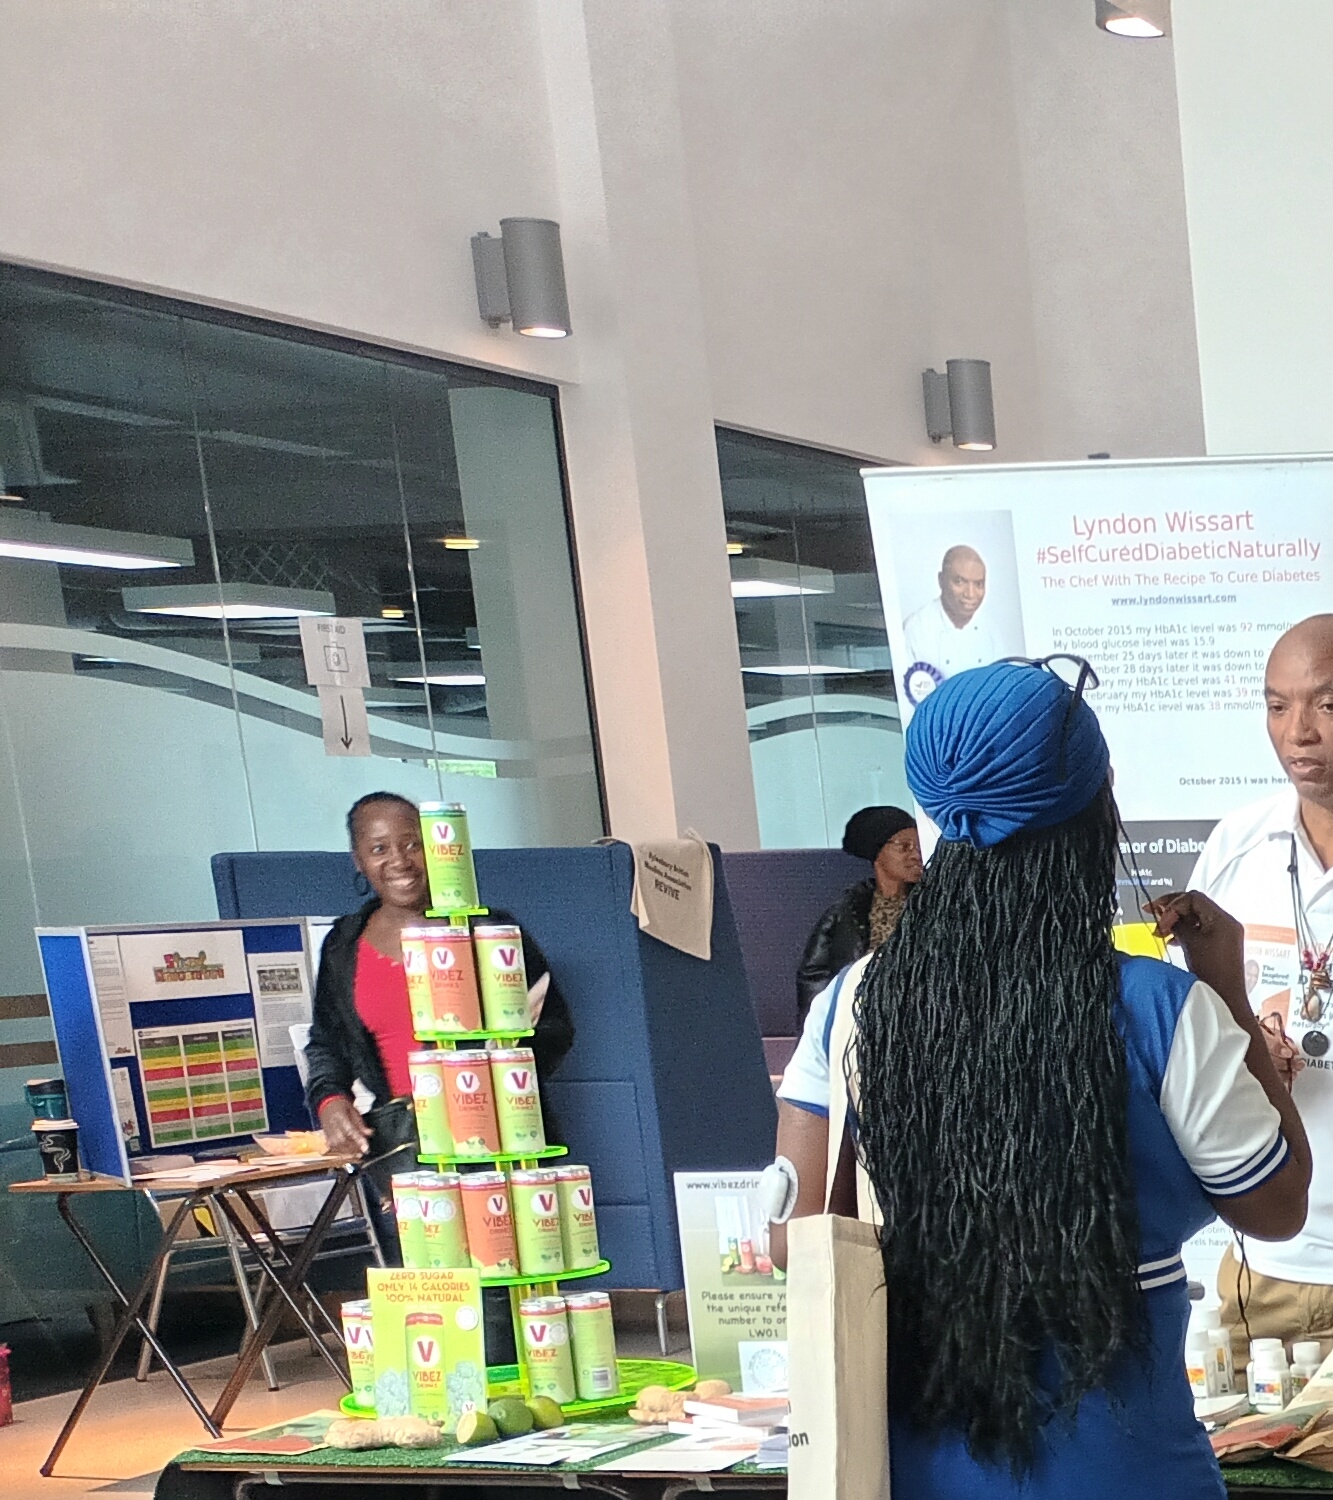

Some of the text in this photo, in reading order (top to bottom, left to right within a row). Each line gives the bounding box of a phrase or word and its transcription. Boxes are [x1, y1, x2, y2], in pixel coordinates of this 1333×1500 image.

[1072, 510, 1255, 541] Lyndon Wissart
[1036, 538, 1321, 564] #SelfCuredDiabeticNaturally
[1041, 568, 1321, 588] The Chef With The Recipe To Cure Diabetes
[1111, 593, 1237, 607] www.lyndonwissart.com
[1052, 627, 1062, 637] In
[1064, 626, 1104, 637] October
[1107, 625, 1133, 636] 2015
[1136, 627, 1152, 637] my
[1154, 624, 1188, 635] HbA1c
[1190, 623, 1215, 634] level
[1217, 624, 1237, 633] was
[1053, 640, 1069, 651] My
[1071, 639, 1099, 650] blood
[1101, 638, 1140, 650] glucose
[1142, 637, 1167, 649] level
[1170, 638, 1190, 647] was
[1121, 648, 1264, 663] 25 days later it was down to
[1139, 663, 1164, 676] days
[1165, 662, 1190, 673] later
[1192, 662, 1199, 673] it
[1202, 663, 1222, 672] was
[1224, 661, 1252, 672] down
[1254, 661, 1265, 671] to
[1117, 677, 1133, 688] my
[1201, 676, 1221, 685] was
[1131, 691, 1147, 701] my
[1186, 688, 1210, 698] level
[1212, 688, 1232, 697] was
[1104, 703, 1120, 714] my
[1158, 700, 1183, 711] level
[1185, 701, 1206, 710] was
[1179, 776, 1268, 786] October 2015 was
[436, 824, 449, 840] V
[428, 843, 465, 857] VIBEZ
[1149, 838, 1164, 854] of
[655, 879, 681, 901] REVIVE
[436, 950, 449, 966] V
[499, 948, 517, 968] V
[430, 969, 465, 982] VIBEZ
[493, 972, 525, 984] VIBEZ
[461, 1074, 474, 1089] V
[510, 1071, 529, 1090] V
[452, 1092, 489, 1105] VIBEZ
[506, 1095, 538, 1105] VIBEZ
[492, 1196, 504, 1212] V
[538, 1193, 554, 1212] V
[577, 1189, 591, 1206] V
[1208, 1239, 1229, 1247] have
[389, 1271, 454, 1281] ZERO SUGAR
[377, 1282, 405, 1292] ONLY
[421, 1282, 471, 1291] CALORIES
[385, 1293, 465, 1303] 100% NATURAL
[700, 1291, 774, 1302] Please ensure
[706, 1302, 762, 1317] the unique
[718, 1315, 773, 1326] number to
[347, 1326, 362, 1345] V
[529, 1324, 547, 1343] V
[748, 1328, 780, 1339] LW01
[416, 1340, 434, 1363] V
[527, 1348, 558, 1358] VIBEZ
[412, 1370, 442, 1383] VIBEZ
